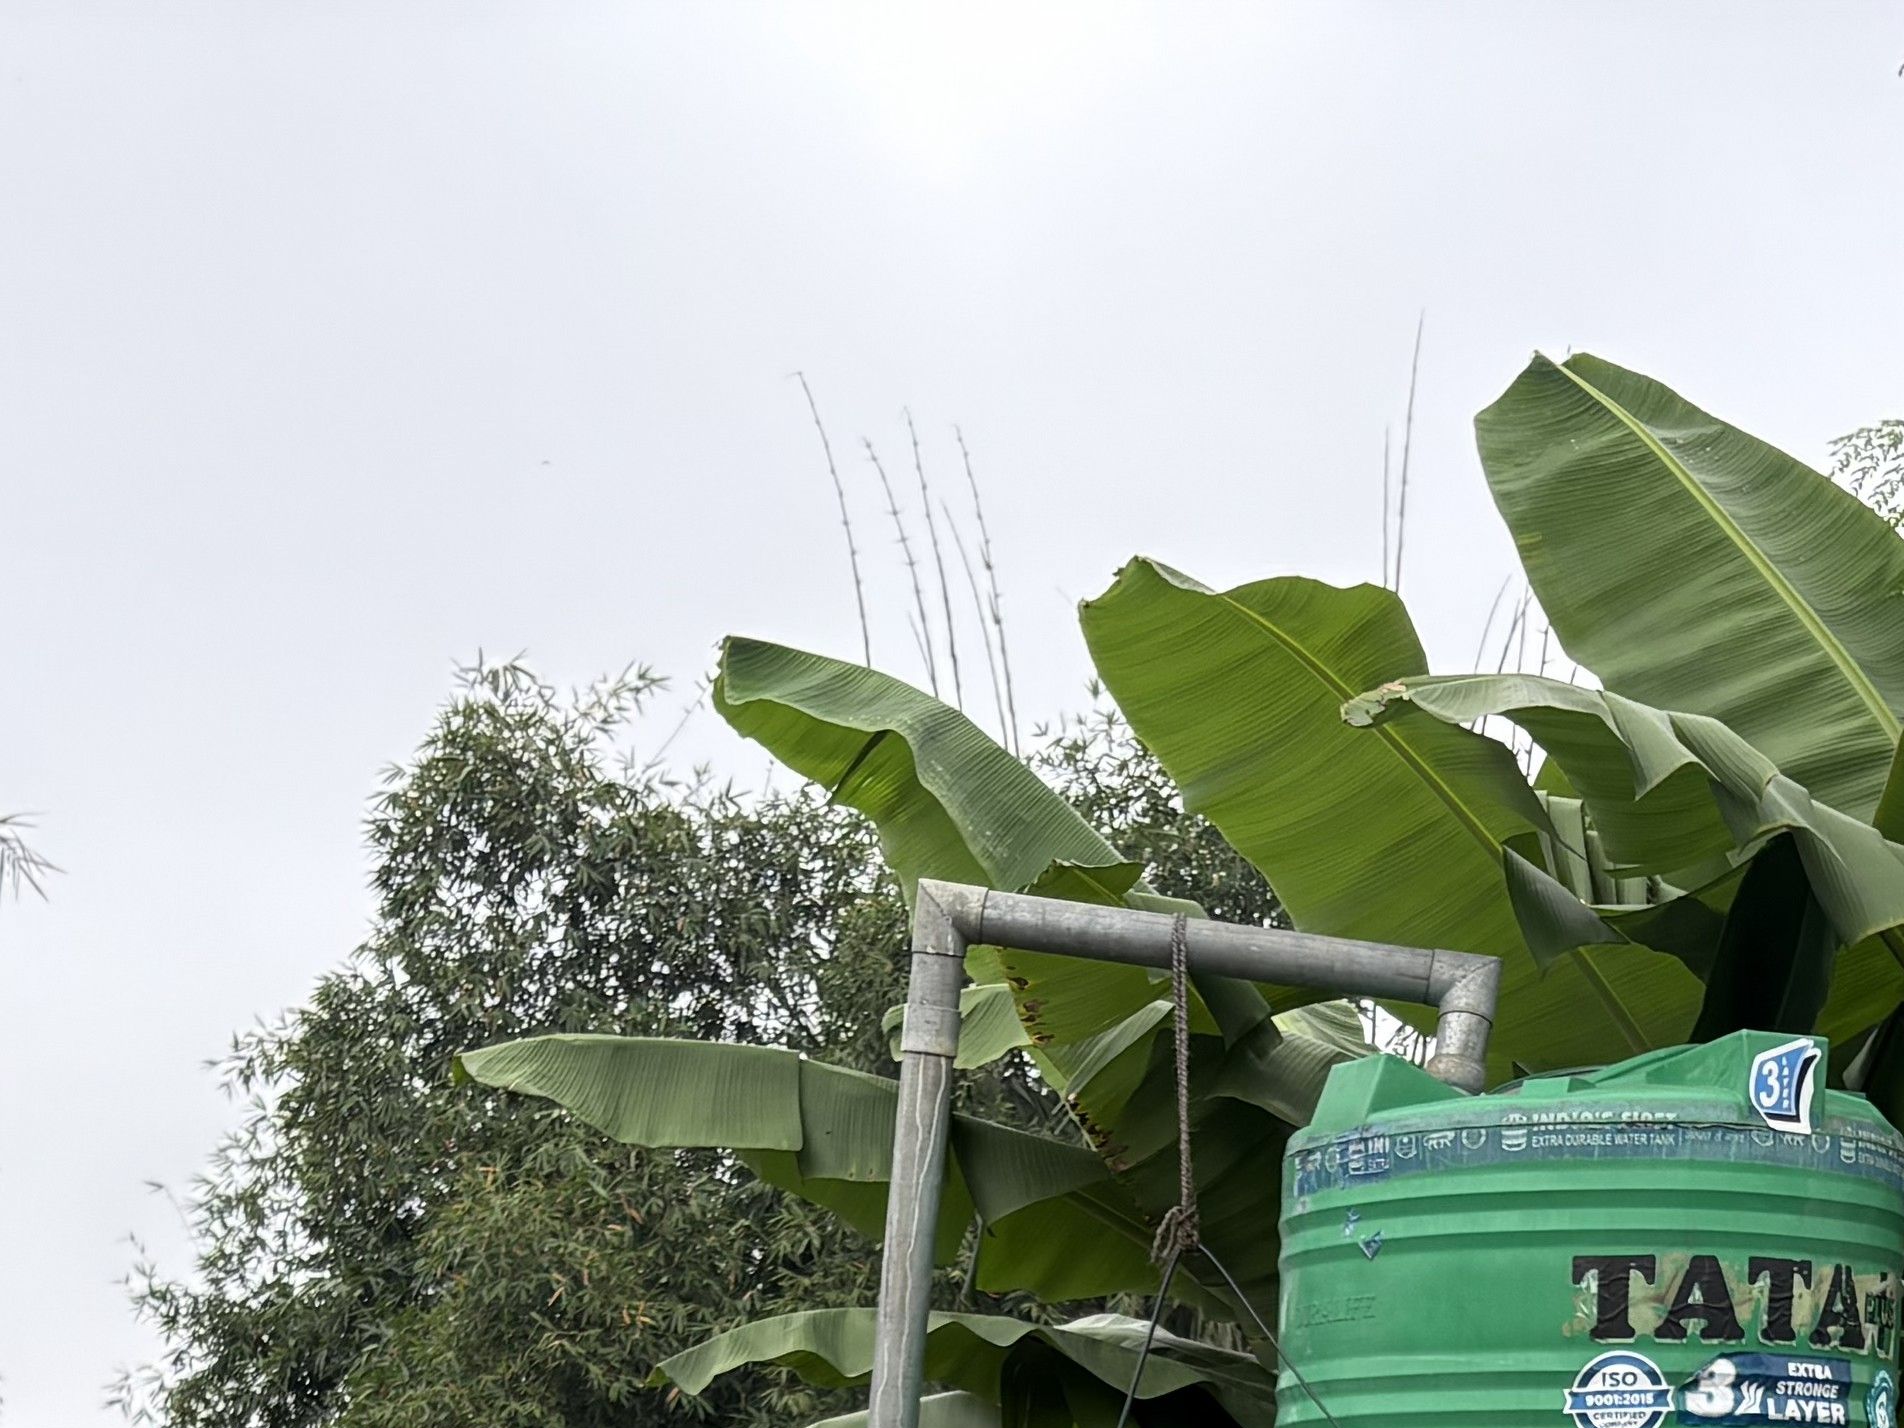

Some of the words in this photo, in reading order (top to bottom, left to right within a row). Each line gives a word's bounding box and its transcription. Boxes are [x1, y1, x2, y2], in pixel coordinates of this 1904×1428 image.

[1759, 1060, 1780, 1107] 3
[1532, 1134, 1563, 1148] EXTRA
[1565, 1133, 1612, 1147] DURABLE
[1615, 1133, 1648, 1146] WATER
[1649, 1133, 1676, 1146] TANK
[1572, 1254, 1866, 1350] TATA
[1602, 1371, 1637, 1387] ISO
[1684, 1358, 1737, 1417] 3
[1585, 1393, 1654, 1406] 9001:2015
[1593, 1411, 1646, 1420] CERTIFIED
[1767, 1398, 1845, 1425] LAYER
